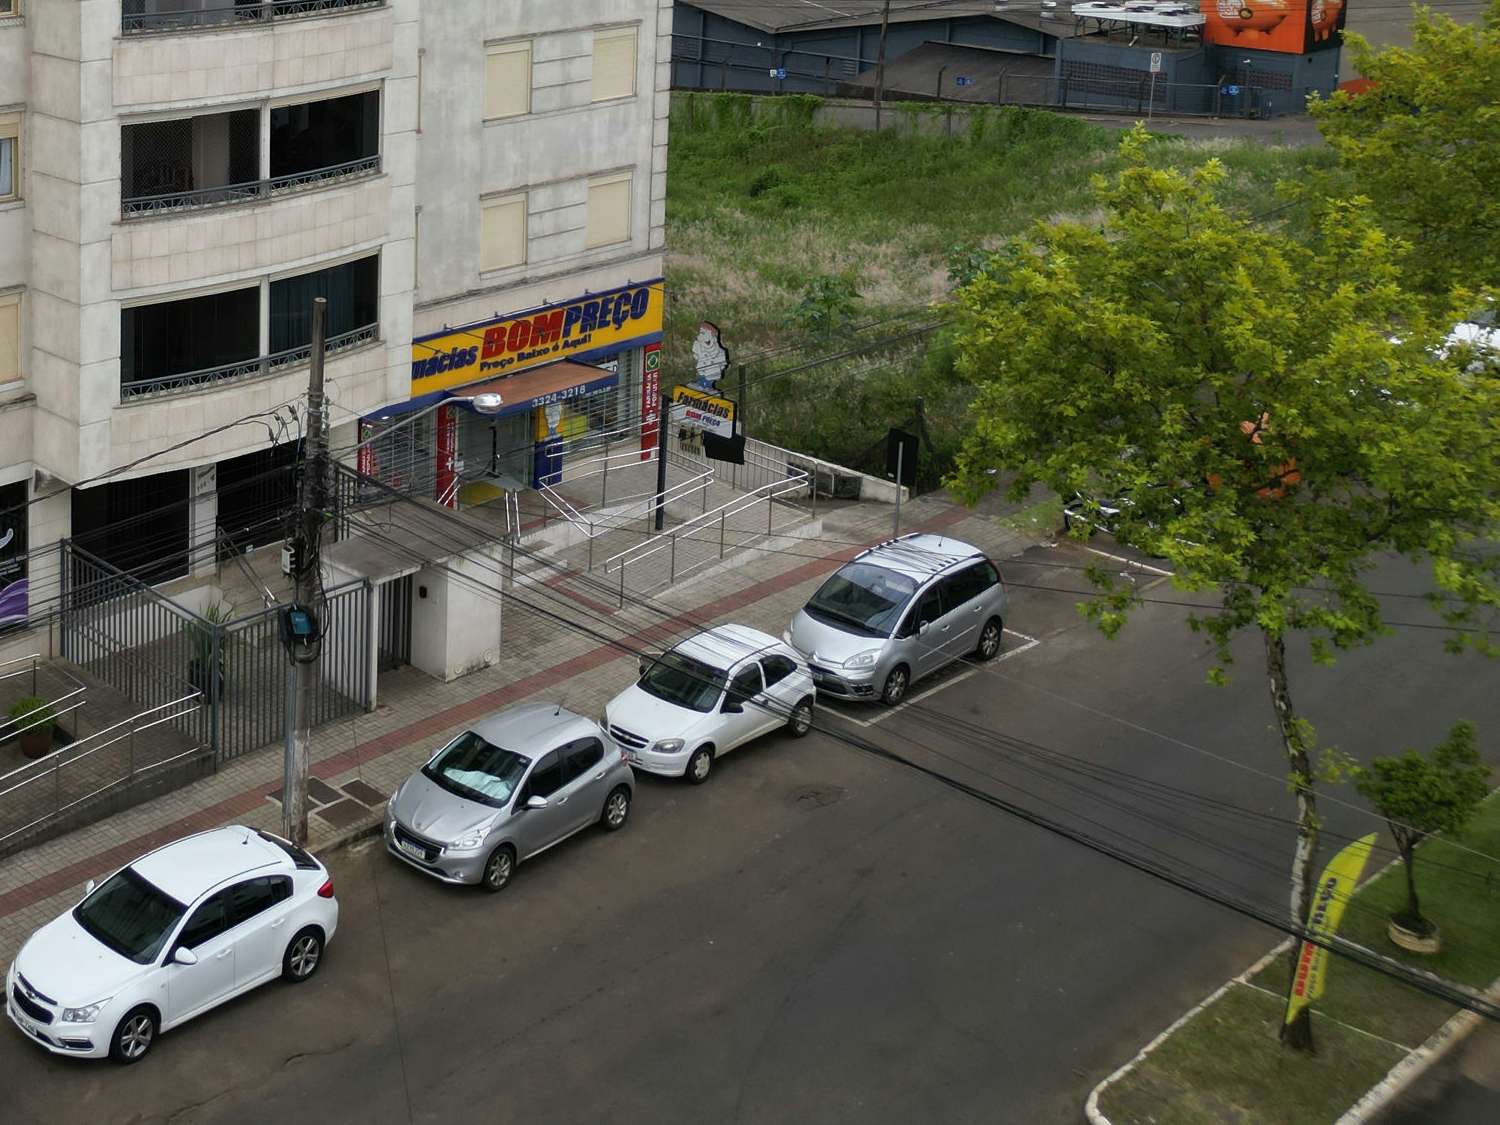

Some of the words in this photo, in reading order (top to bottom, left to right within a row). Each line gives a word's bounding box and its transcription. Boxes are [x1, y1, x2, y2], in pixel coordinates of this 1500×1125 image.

[480, 357, 515, 372] Preço
[517, 347, 550, 363] Baixo
[552, 341, 560, 352] é
[562, 333, 592, 350] Aqui!
[531, 384, 586, 408] 3324-3218
[677, 391, 730, 419] Farmácias
